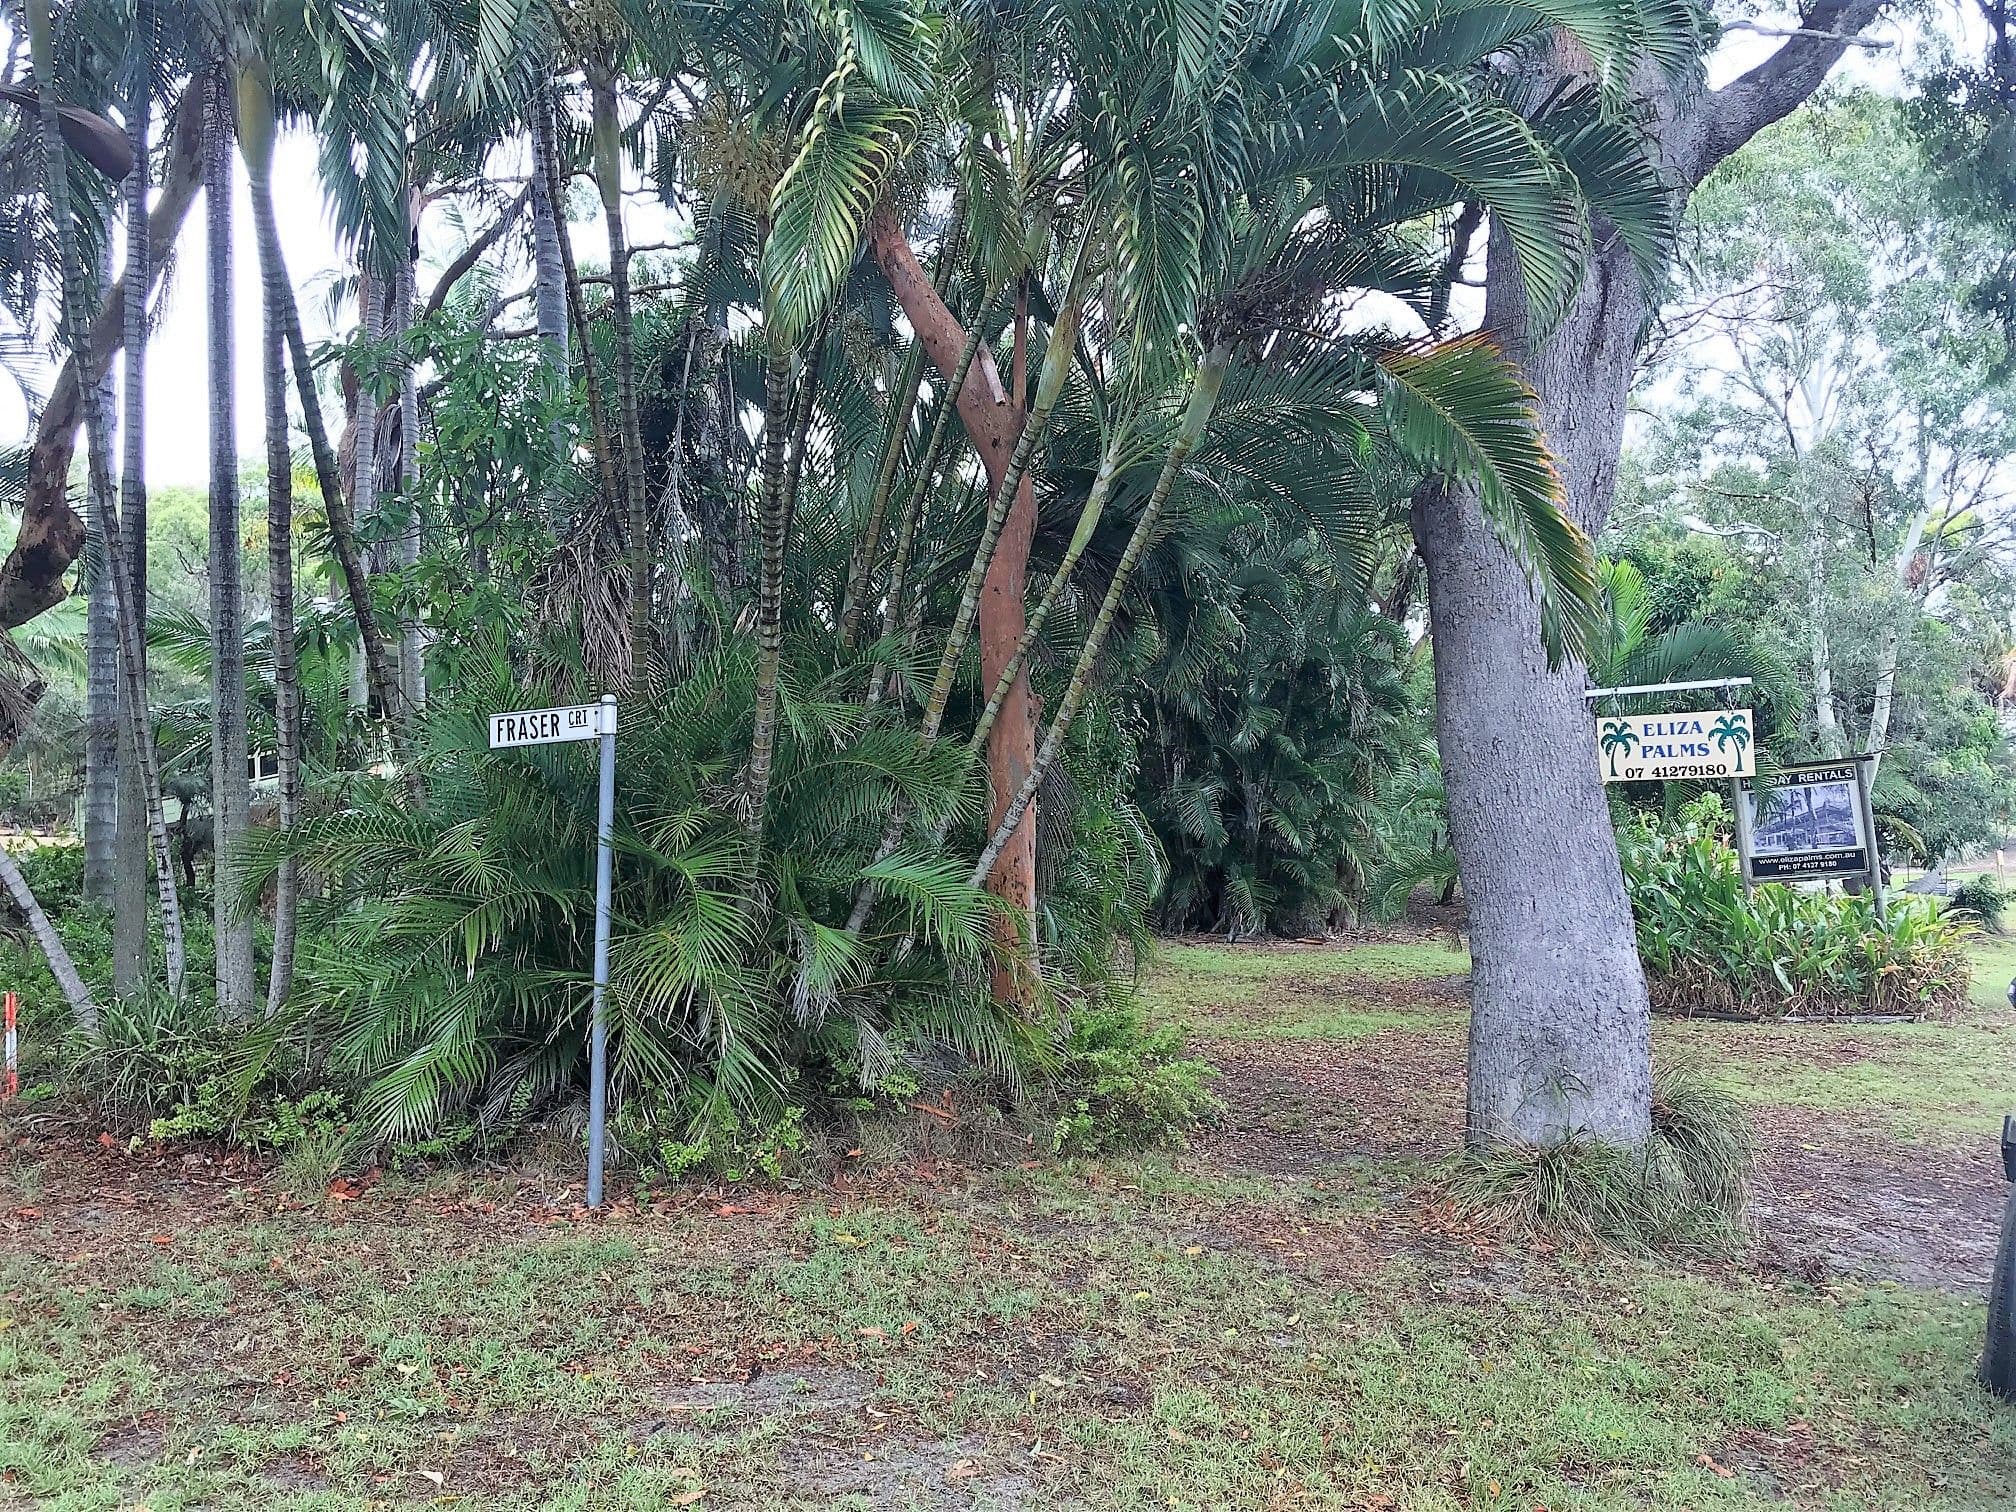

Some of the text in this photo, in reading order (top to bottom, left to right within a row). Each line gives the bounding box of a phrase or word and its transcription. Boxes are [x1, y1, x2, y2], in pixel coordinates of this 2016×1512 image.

[497, 710, 588, 742] FRASER CRT
[1643, 721, 1704, 737] ELIZA
[1641, 743, 1711, 759] PALMS
[1625, 764, 1727, 778] 07 41279180
[1798, 769, 1853, 783] RENTALS
